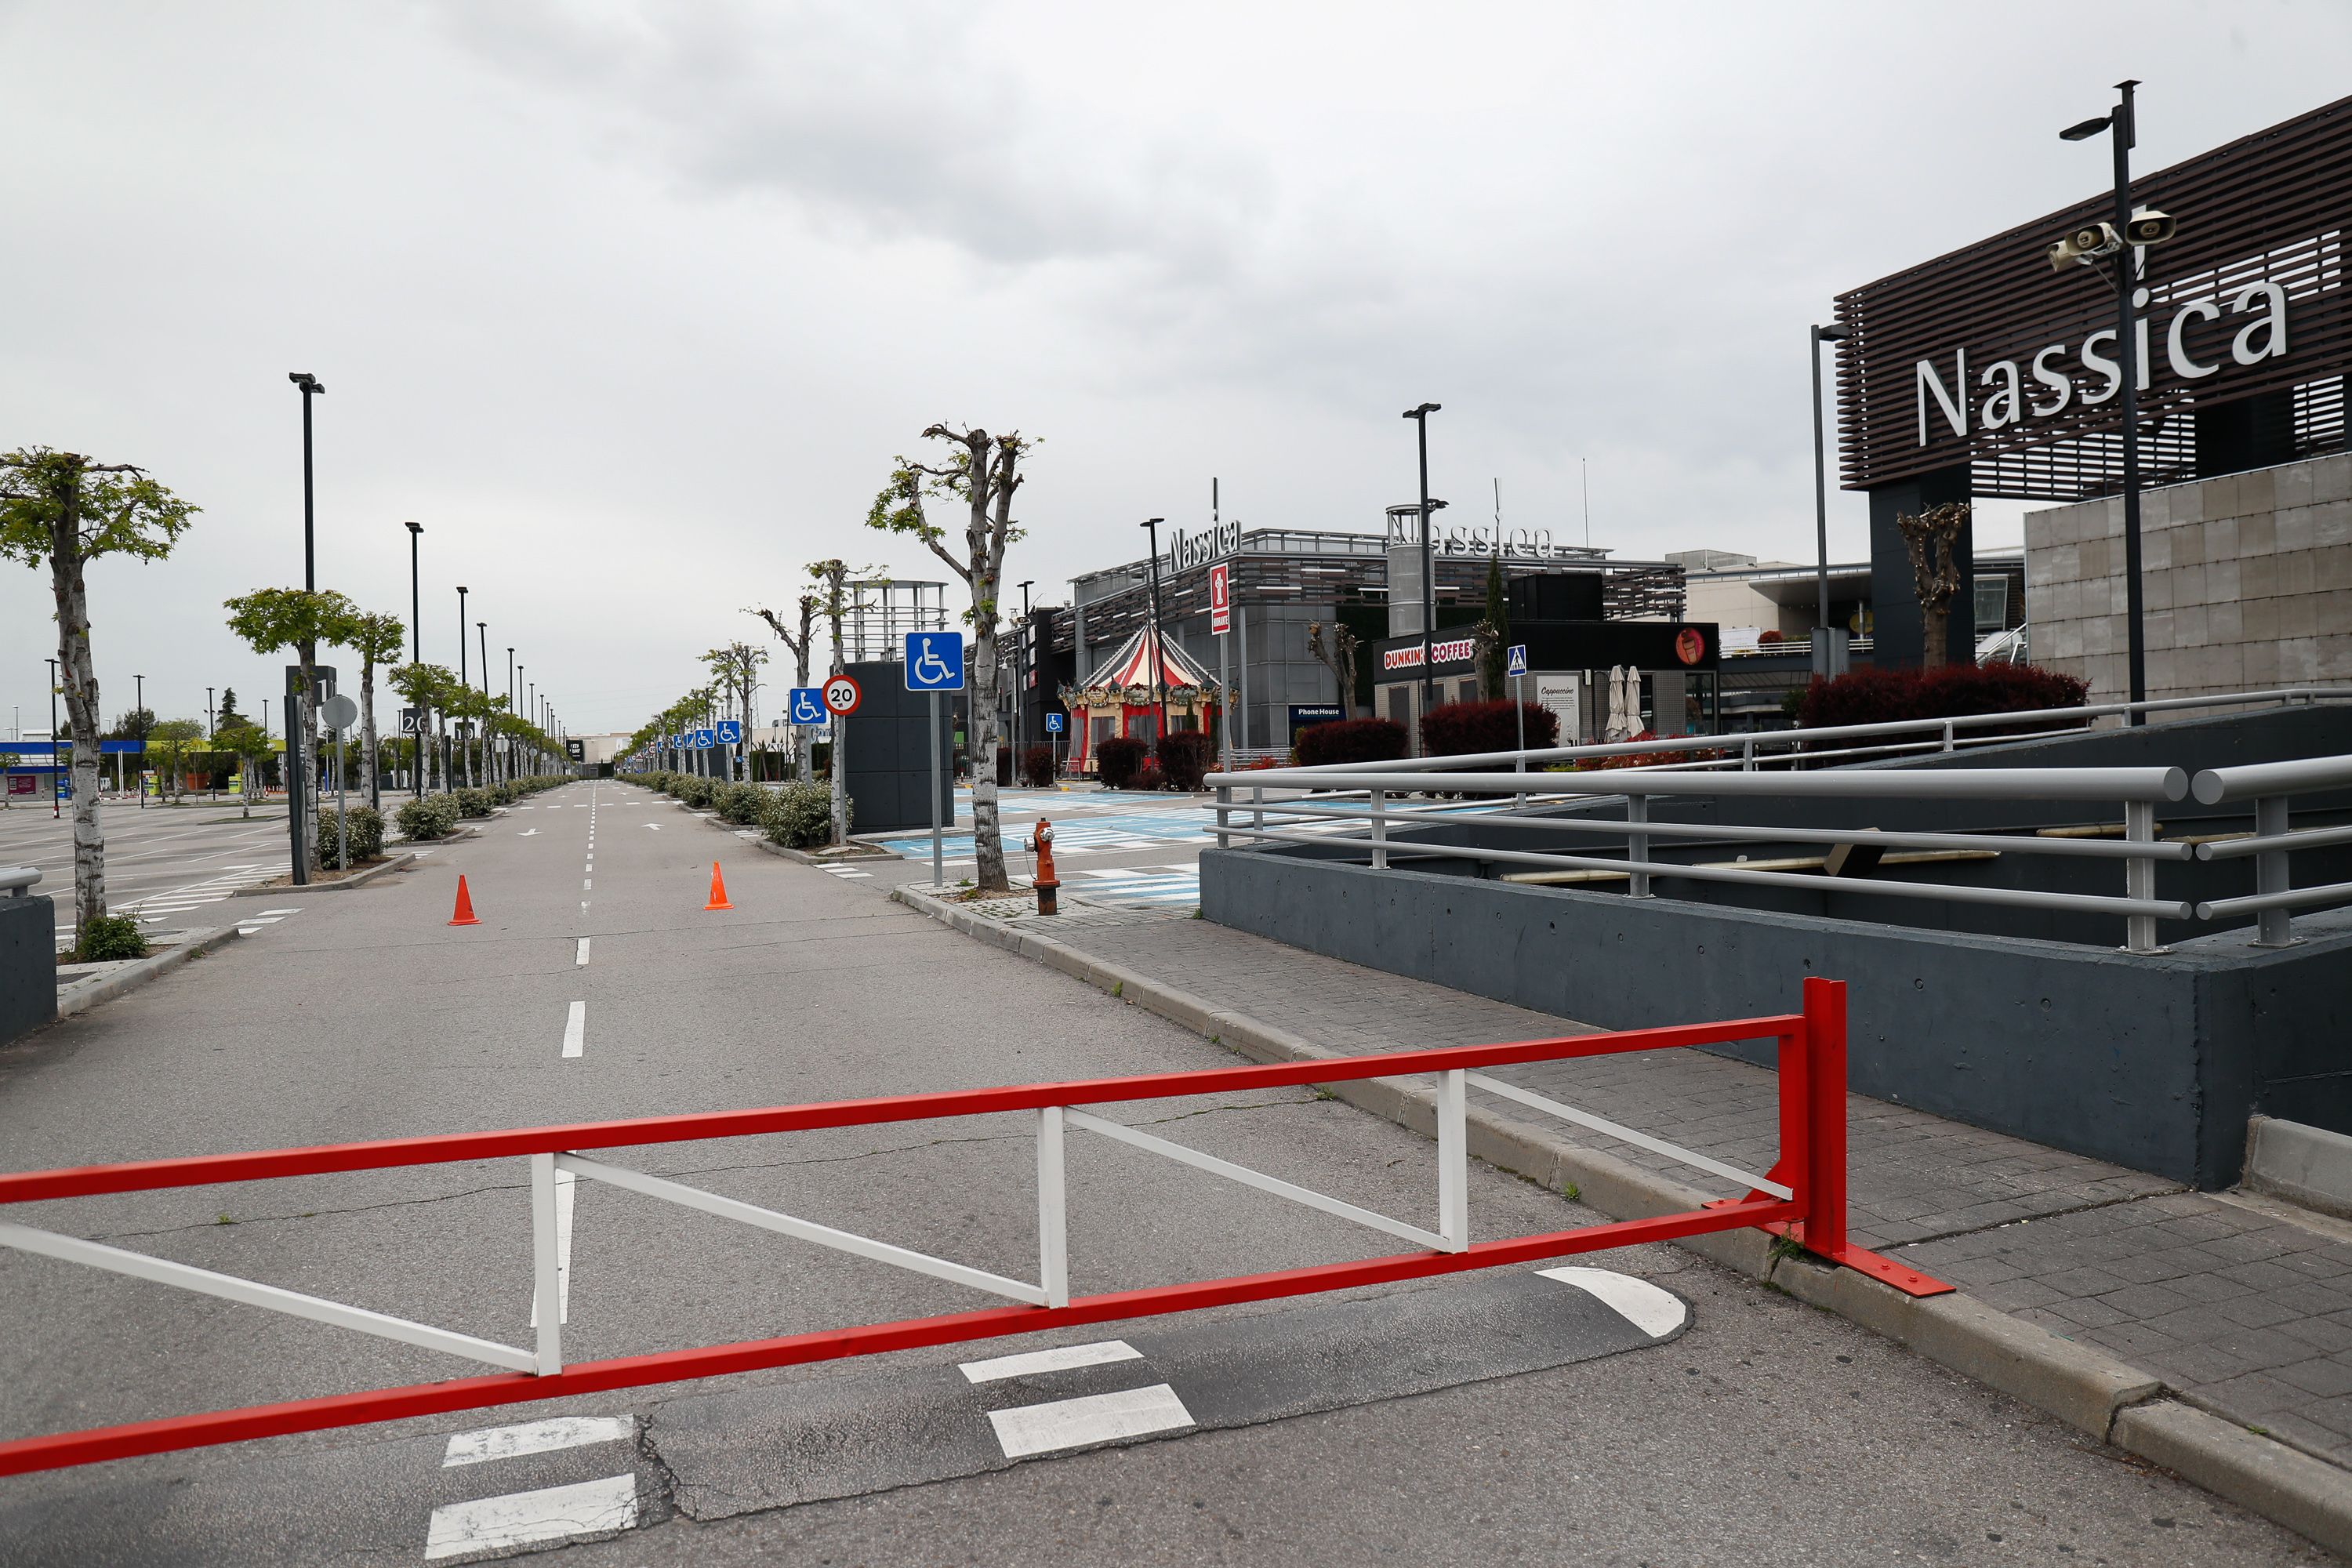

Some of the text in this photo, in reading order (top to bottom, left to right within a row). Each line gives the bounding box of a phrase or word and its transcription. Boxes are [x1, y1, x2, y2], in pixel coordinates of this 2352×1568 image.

[1916, 281, 2288, 447] Nassica
[1171, 513, 1241, 572] Nassica
[1432, 641, 1470, 662] COFFEE
[831, 688, 852, 702] 20
[1541, 686, 1574, 697] Cappuccino
